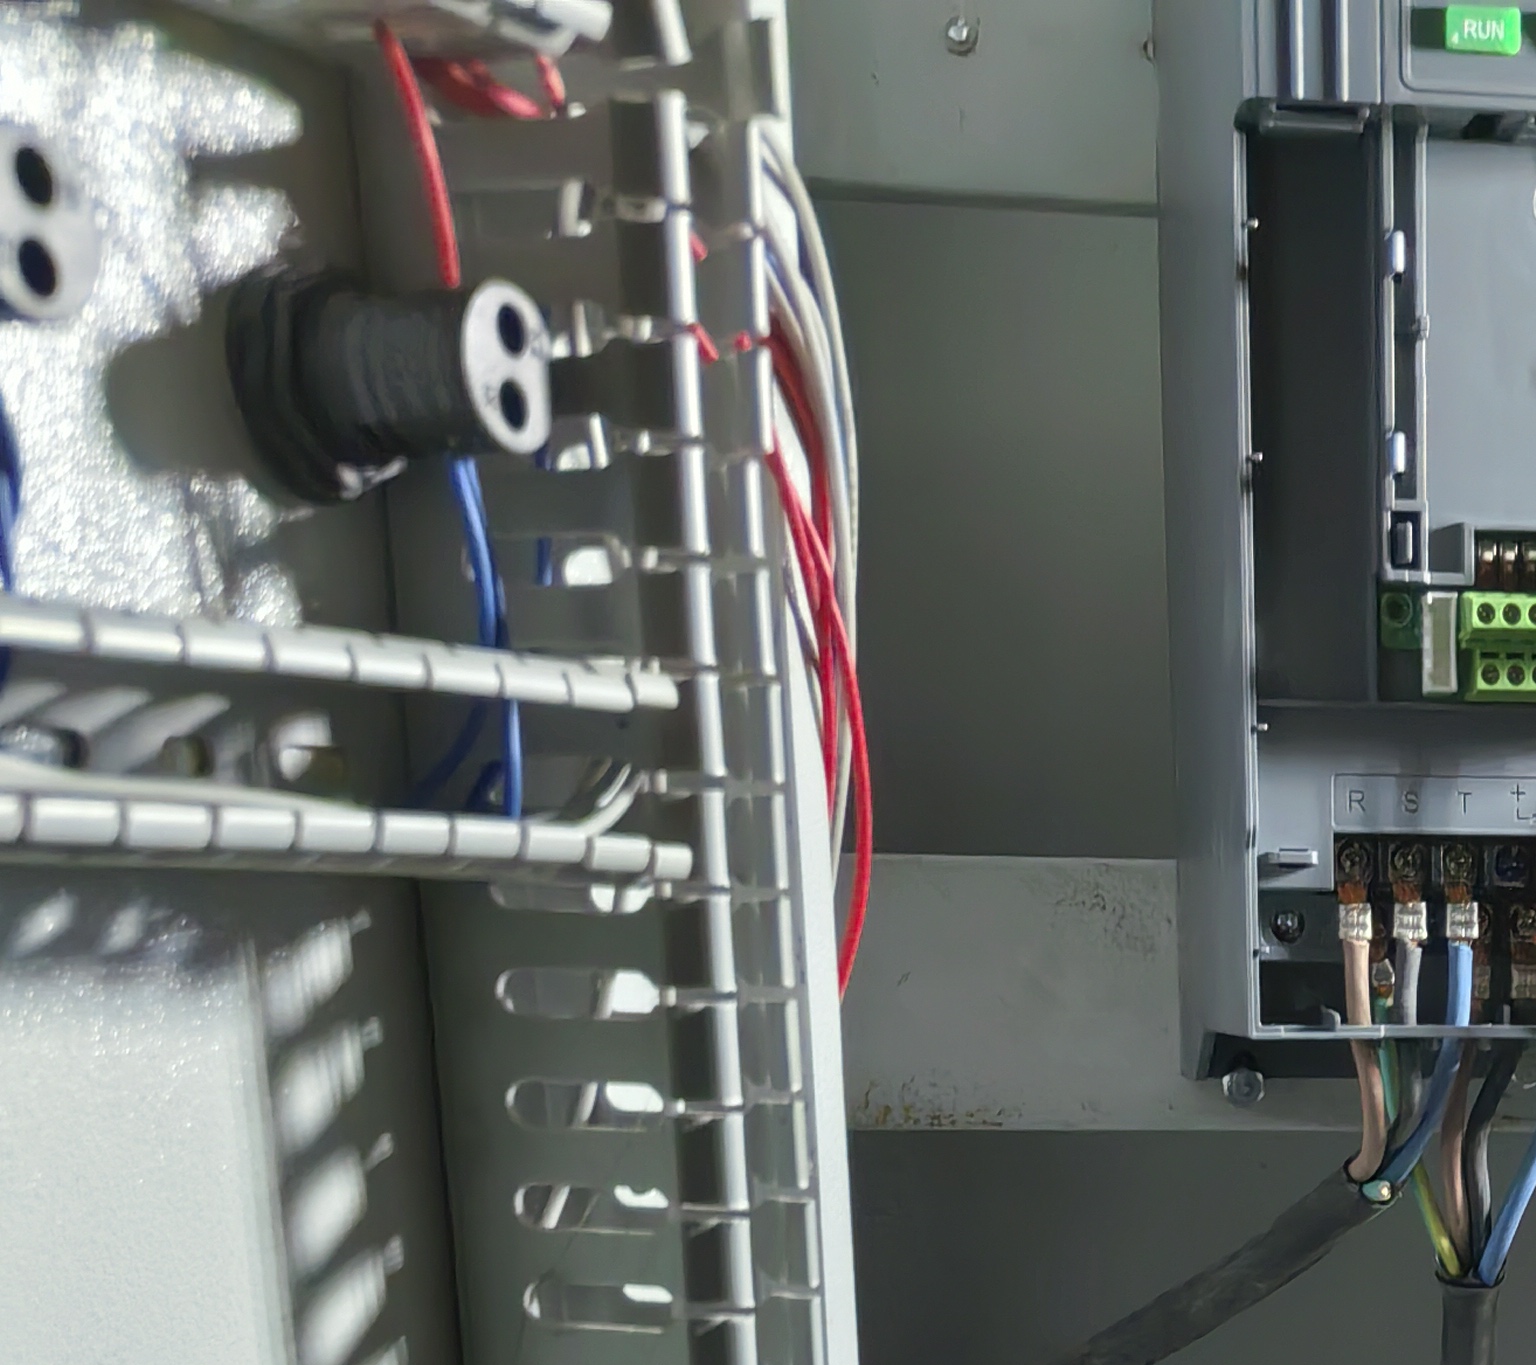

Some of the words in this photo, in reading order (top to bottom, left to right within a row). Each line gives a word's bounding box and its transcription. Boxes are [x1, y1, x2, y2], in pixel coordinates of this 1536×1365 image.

[1463, 19, 1505, 41] RUN
[1348, 788, 1367, 813] R
[1403, 790, 1420, 813] S
[1457, 791, 1473, 815] T
